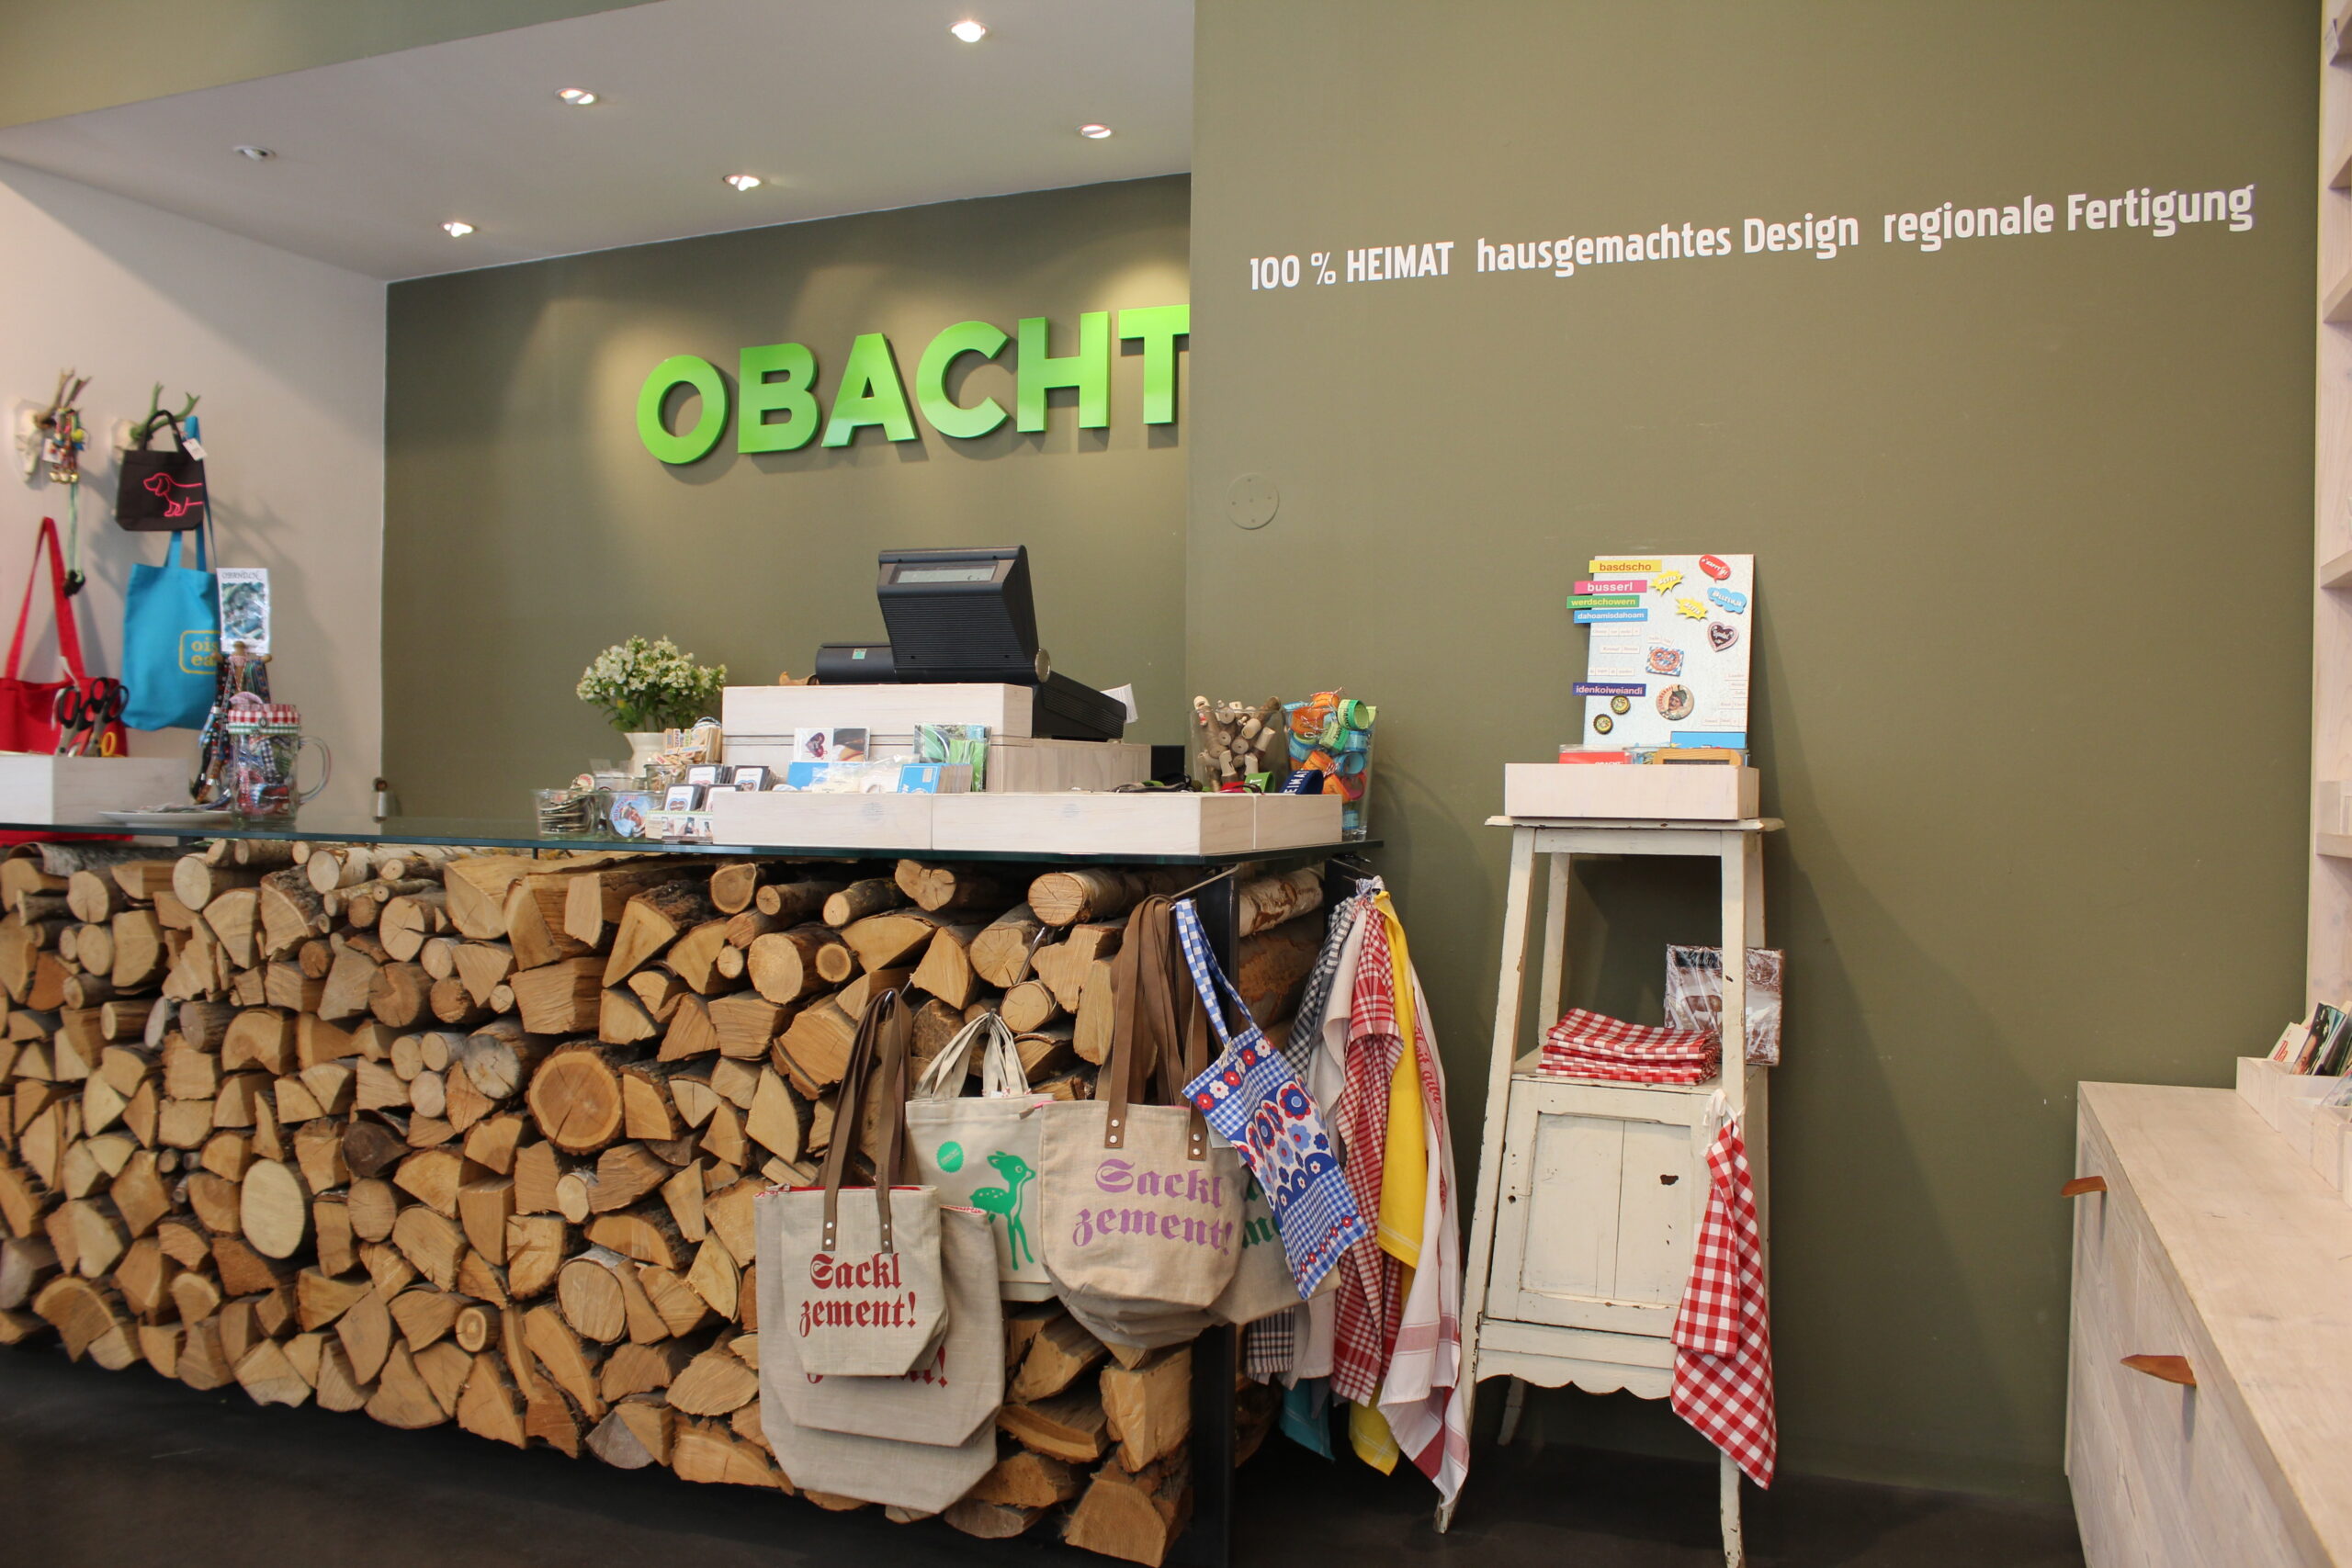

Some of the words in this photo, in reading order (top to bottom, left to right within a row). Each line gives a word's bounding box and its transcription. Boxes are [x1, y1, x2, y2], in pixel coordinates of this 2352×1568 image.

[1250, 254, 1300, 291] 100
[1310, 251, 1337, 286] %
[1347, 241, 1454, 283] HEIMAT
[1477, 222, 1732, 277] hausgemachtes
[1744, 212, 1859, 260] Design
[1883, 195, 2054, 252] regionale
[2067, 184, 2255, 238] Fertigung
[636, 304, 1190, 465] OBACHT
[1587, 581, 1634, 592] busserl
[1599, 562, 1652, 571] basdscho
[1571, 598, 1636, 606] werdschowern
[1095, 1158, 1223, 1209] Sackl
[1072, 1208, 1234, 1257] zement!
[809, 1252, 902, 1290] Sackl
[799, 1291, 917, 1338] zement!
